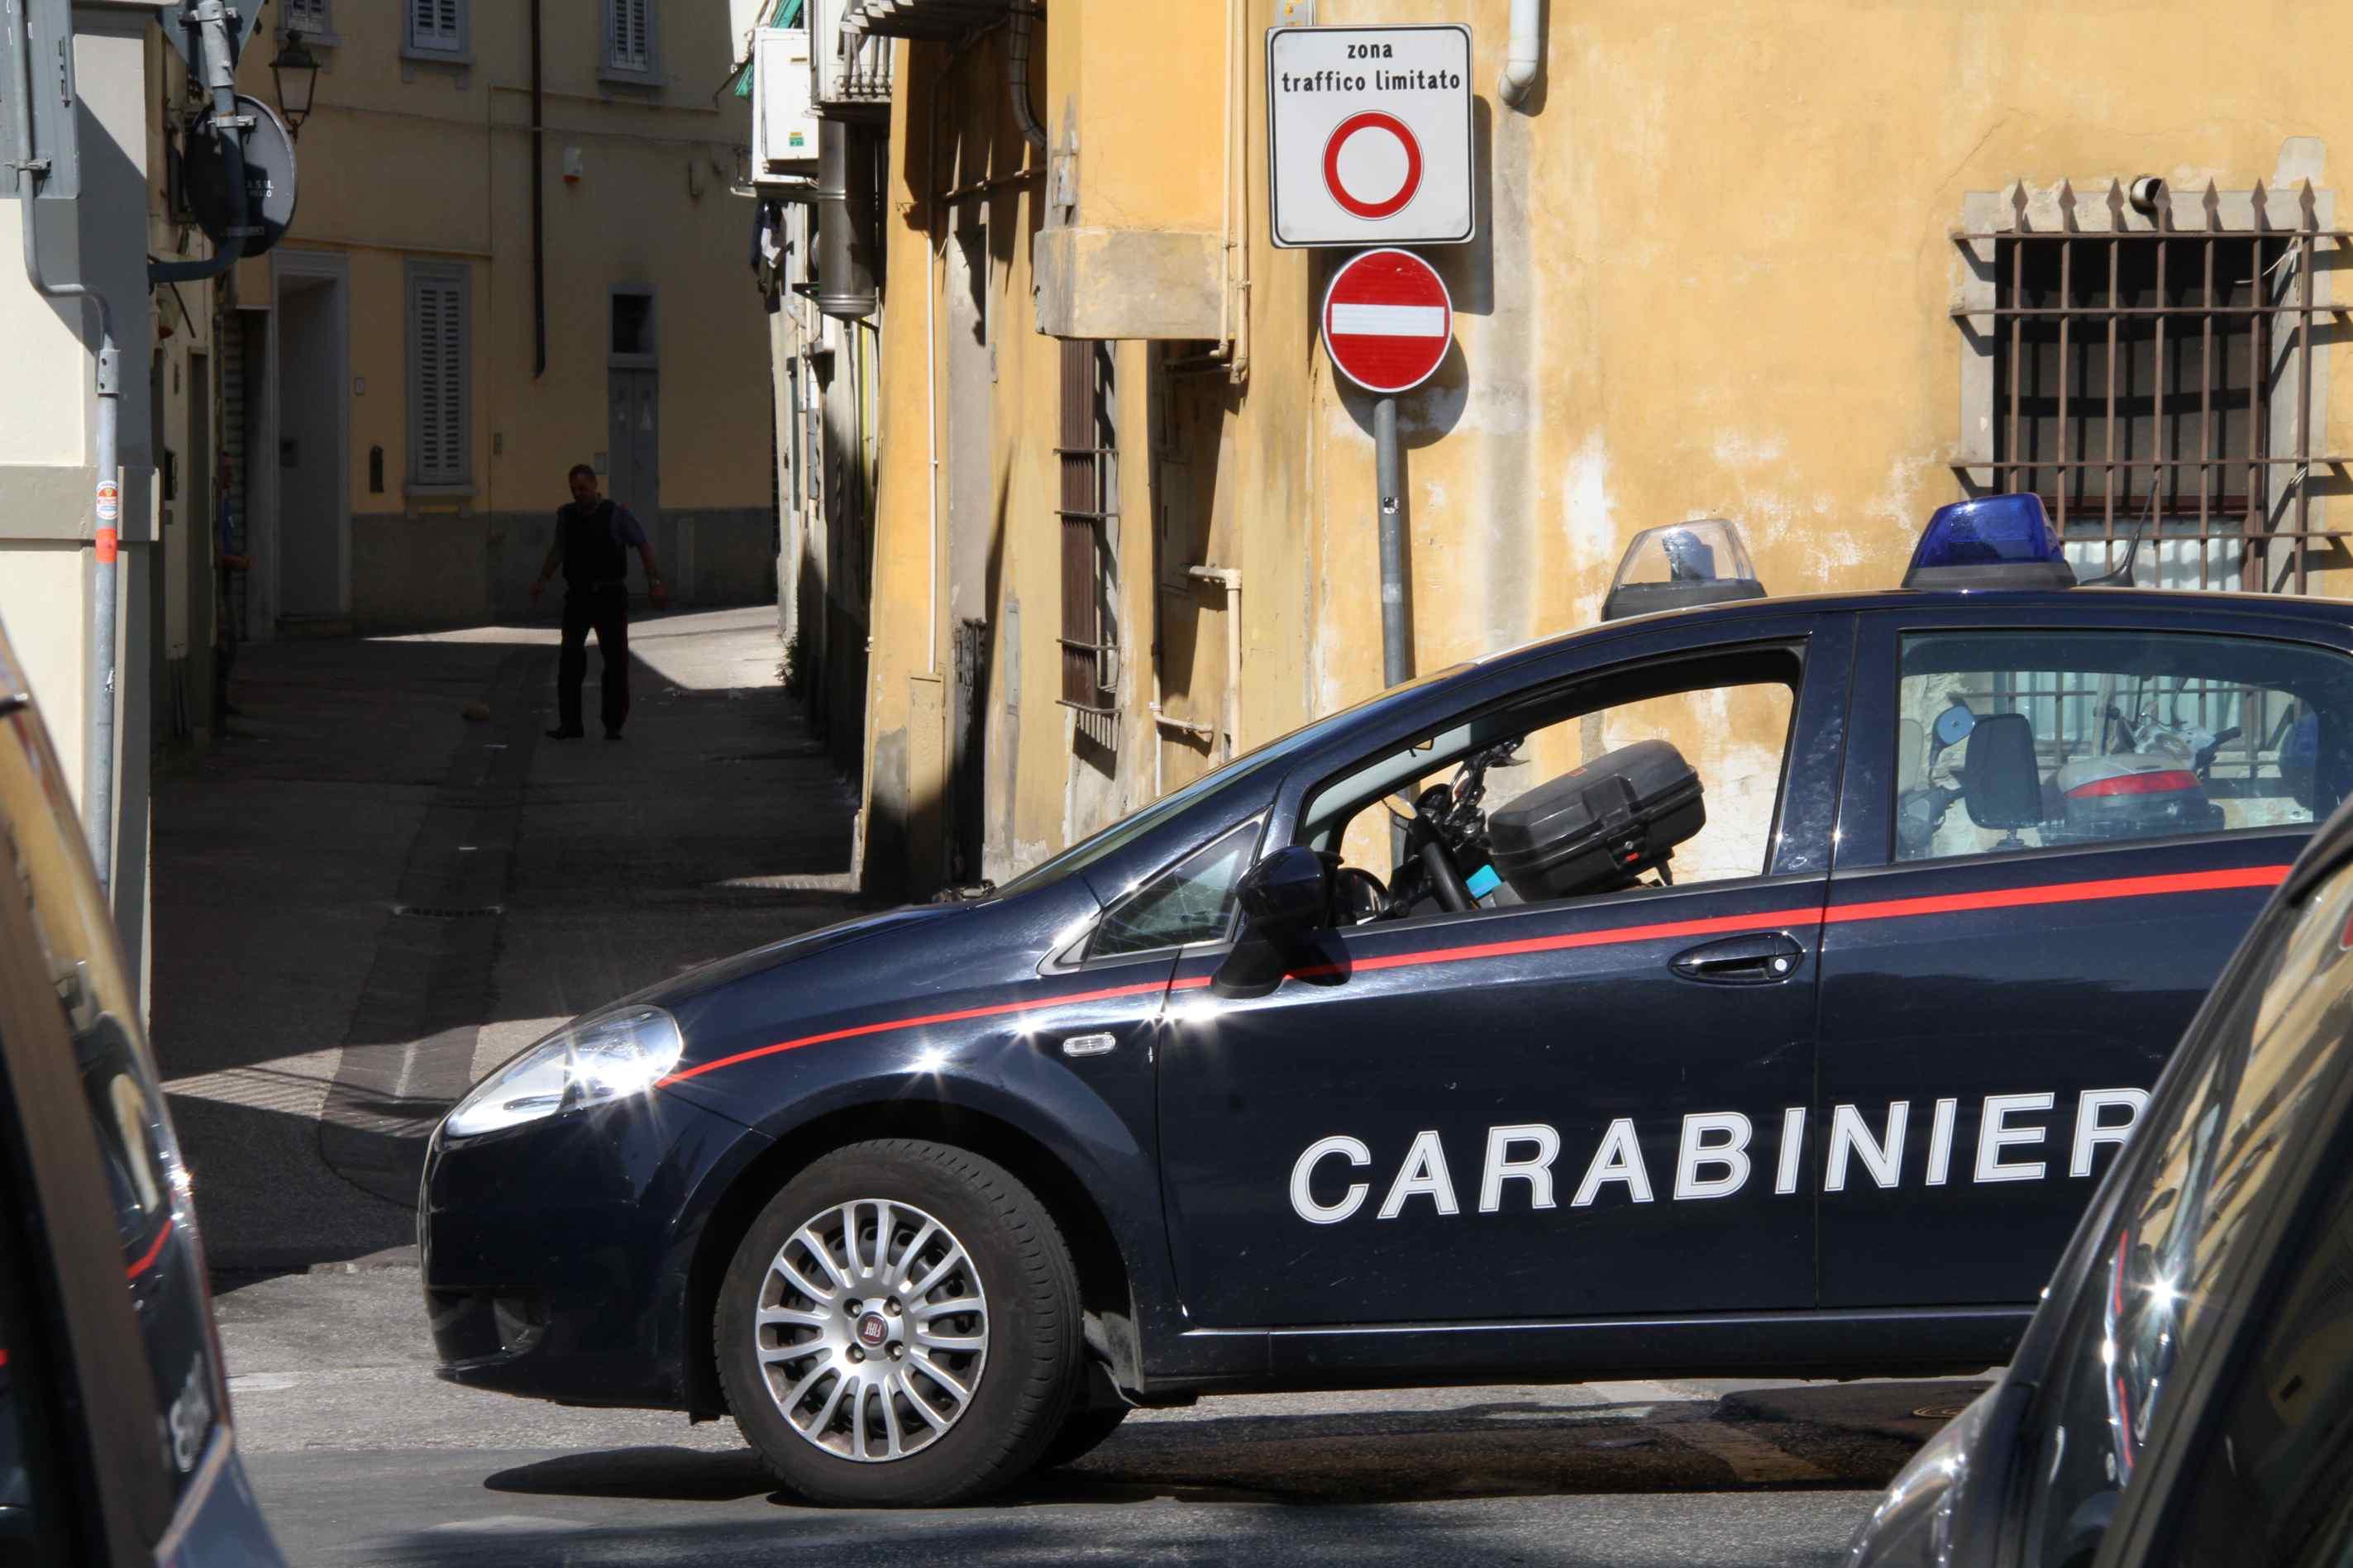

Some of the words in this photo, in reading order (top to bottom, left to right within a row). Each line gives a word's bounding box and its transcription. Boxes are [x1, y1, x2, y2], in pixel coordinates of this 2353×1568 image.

[1348, 44, 1393, 59] zona
[1282, 70, 1366, 92] traffico
[1376, 69, 1460, 90] limitato
[864, 1322, 882, 1337] FIAT
